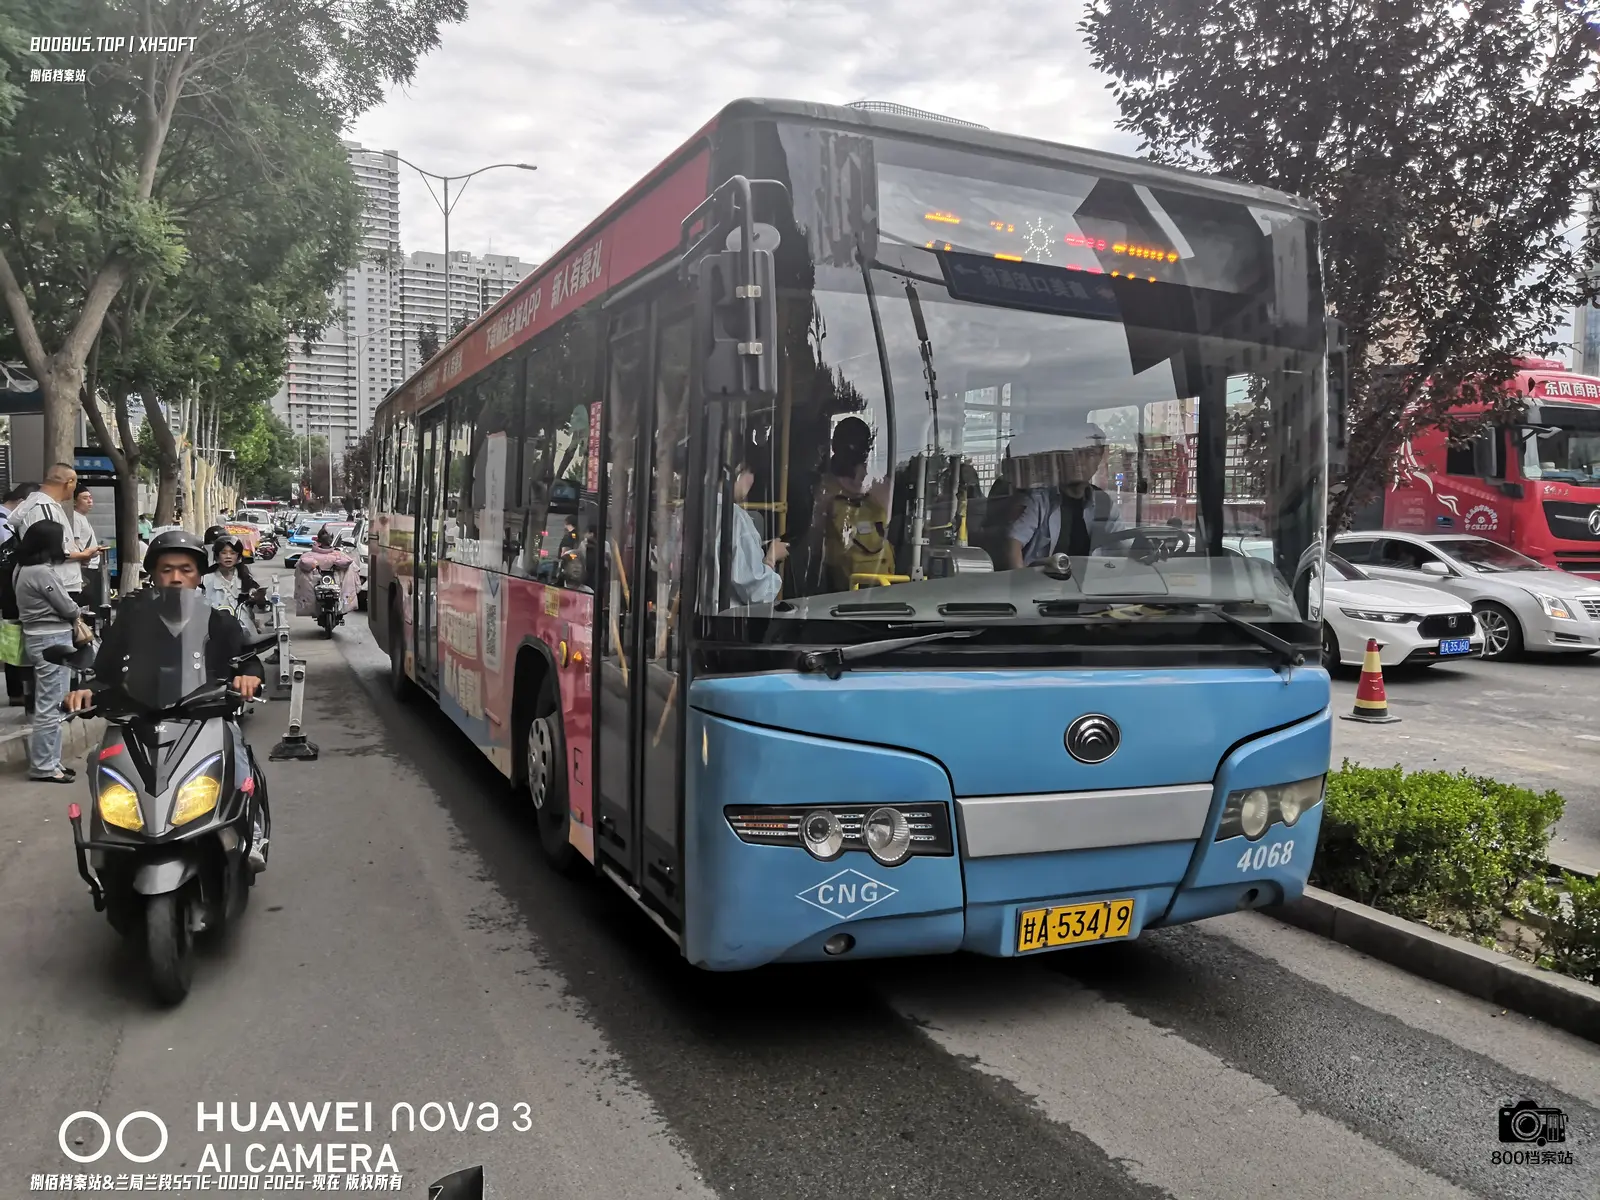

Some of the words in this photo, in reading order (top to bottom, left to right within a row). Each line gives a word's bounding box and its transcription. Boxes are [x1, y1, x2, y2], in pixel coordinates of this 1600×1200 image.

[550, 239, 603, 310] 新人有豪礼
[1545, 381, 1600, 398] 东风商用
[1237, 840, 1294, 872] 4068
[818, 882, 878, 904] CNG
